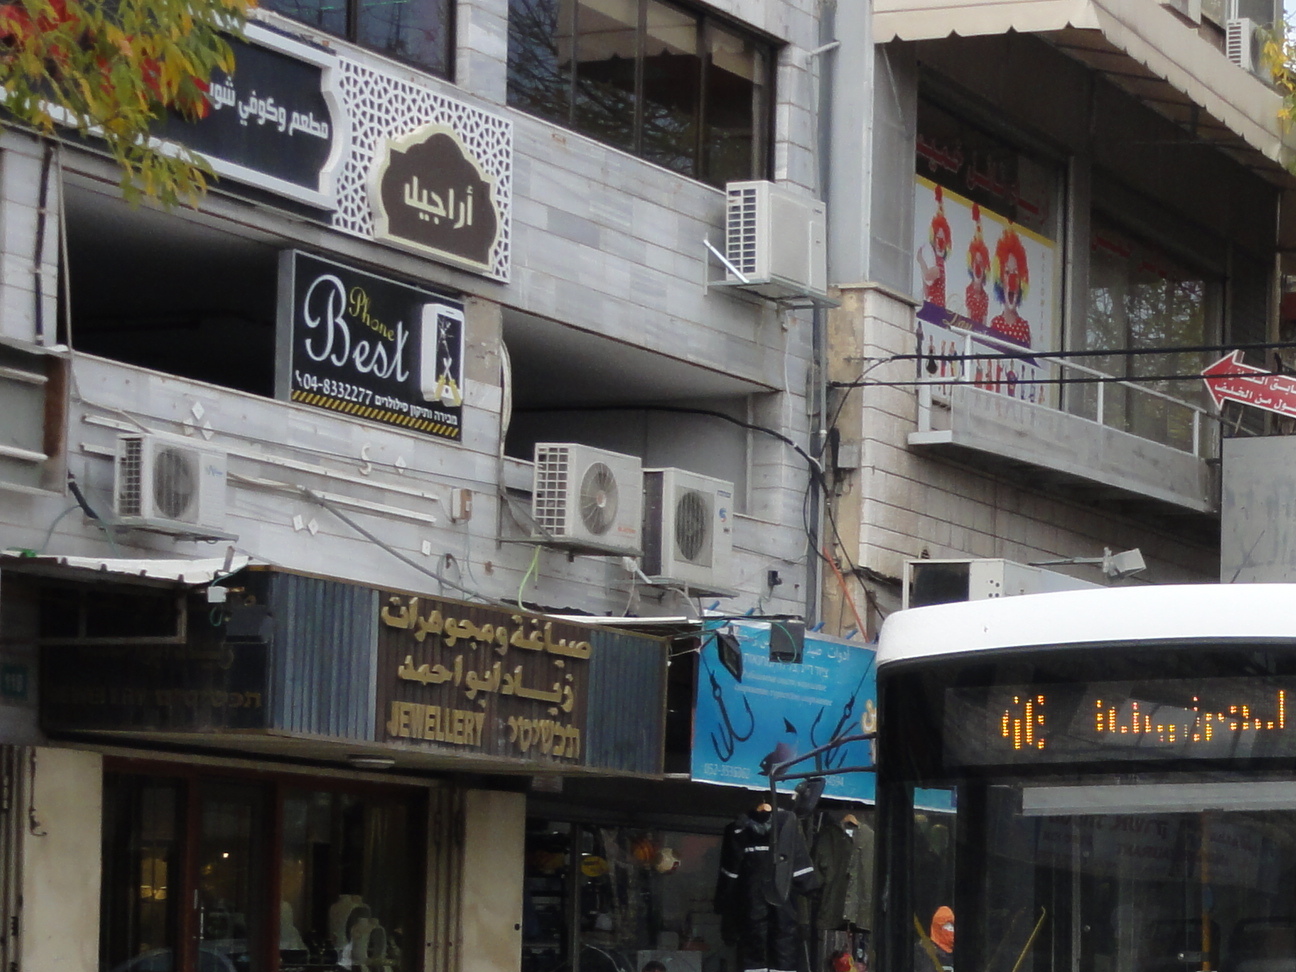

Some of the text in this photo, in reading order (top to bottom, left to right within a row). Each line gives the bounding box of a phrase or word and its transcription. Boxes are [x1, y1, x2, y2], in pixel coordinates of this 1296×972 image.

[238, 90, 286, 132] وكوفي
[289, 111, 329, 140] مطعم
[303, 274, 410, 383] Best
[349, 286, 395, 341] Phone
[303, 373, 373, 405] 04-8332277
[1254, 393, 1272, 404] من
[510, 614, 592, 668] صياغة
[387, 701, 485, 747] JEWELLERY
